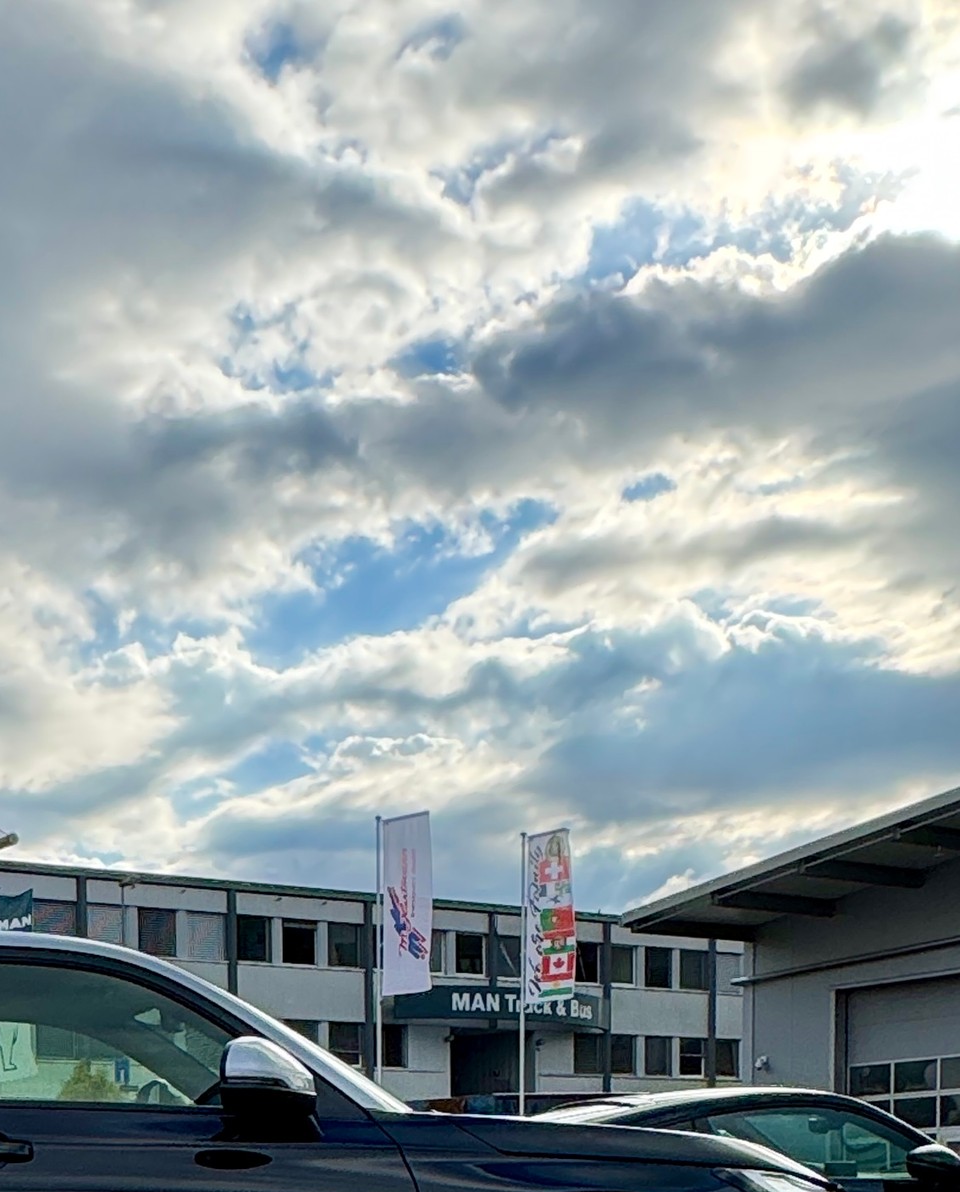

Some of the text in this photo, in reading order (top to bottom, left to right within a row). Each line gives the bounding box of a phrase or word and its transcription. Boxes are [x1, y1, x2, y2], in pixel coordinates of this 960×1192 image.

[451, 992, 500, 1012] MAN
[556, 1000, 566, 1016] &
[570, 1000, 593, 1019] Bus
